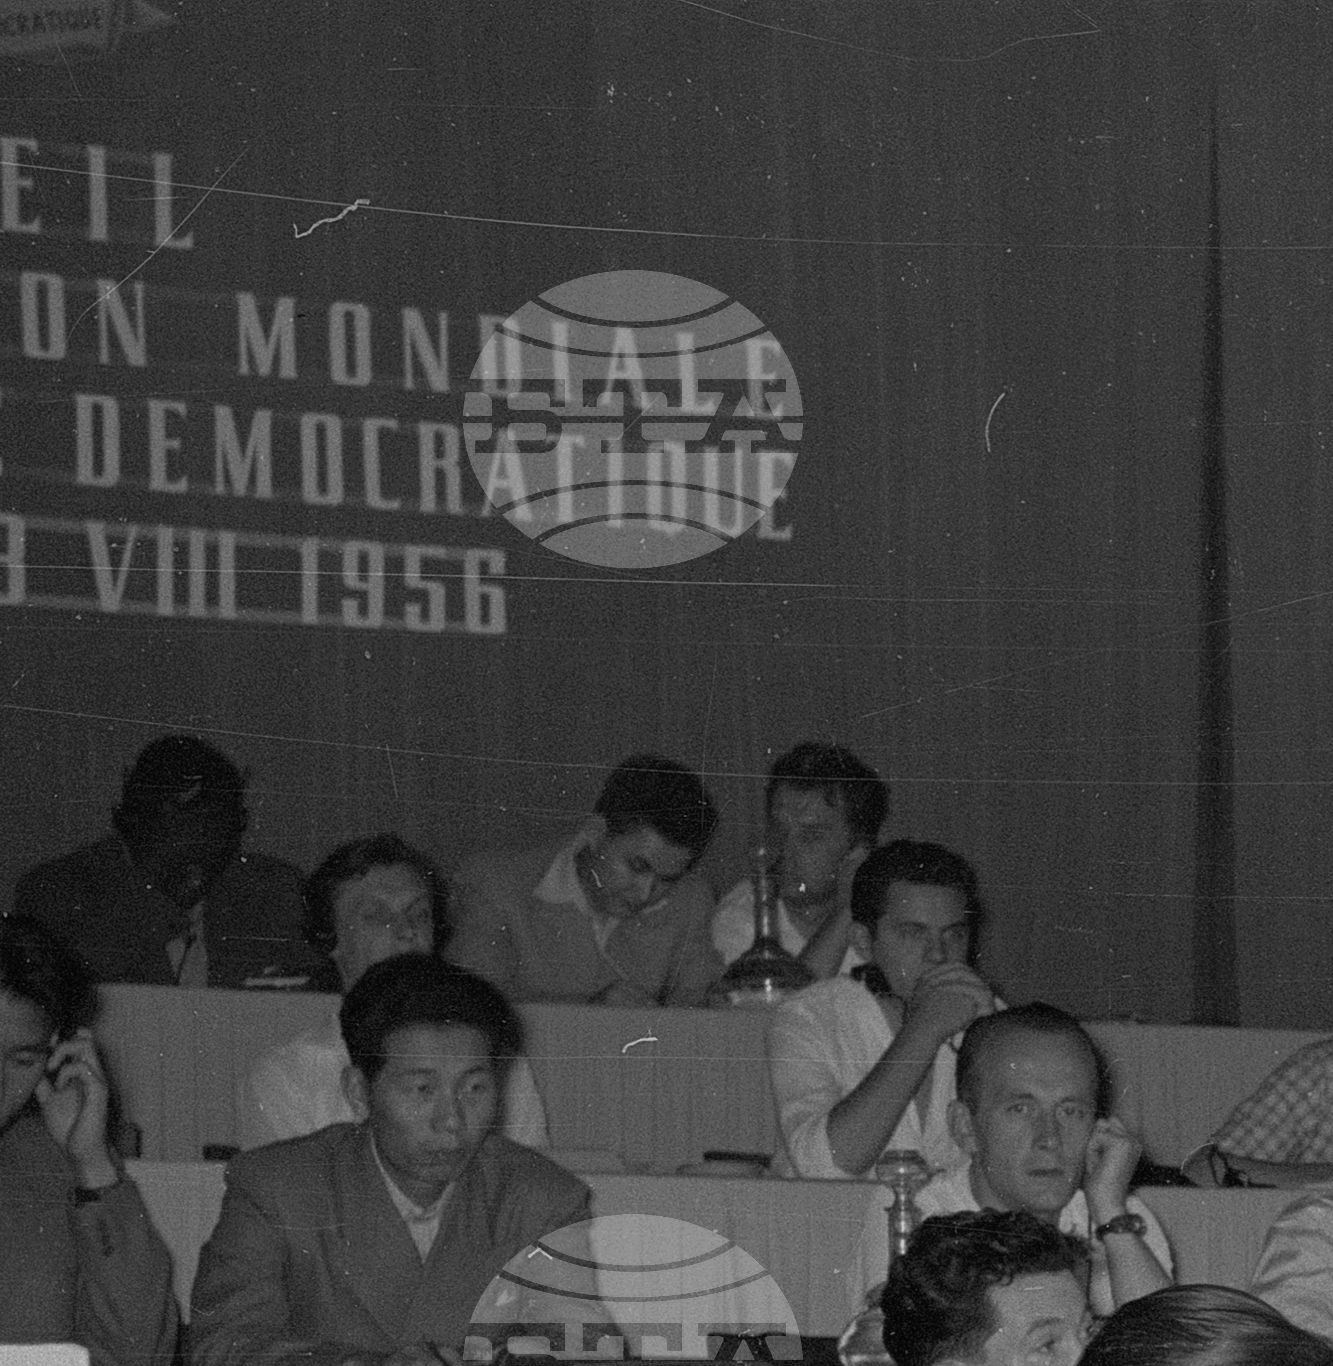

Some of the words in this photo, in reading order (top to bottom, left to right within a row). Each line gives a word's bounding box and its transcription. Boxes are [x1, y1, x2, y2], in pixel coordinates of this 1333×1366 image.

[0, 137, 194, 248] EIL
[20, 271, 148, 368] ON
[237, 291, 786, 421] MONDIALE
[75, 394, 799, 541] DEMOCRATIQUE
[86, 520, 236, 620] VIII
[299, 537, 508, 636] 1956
